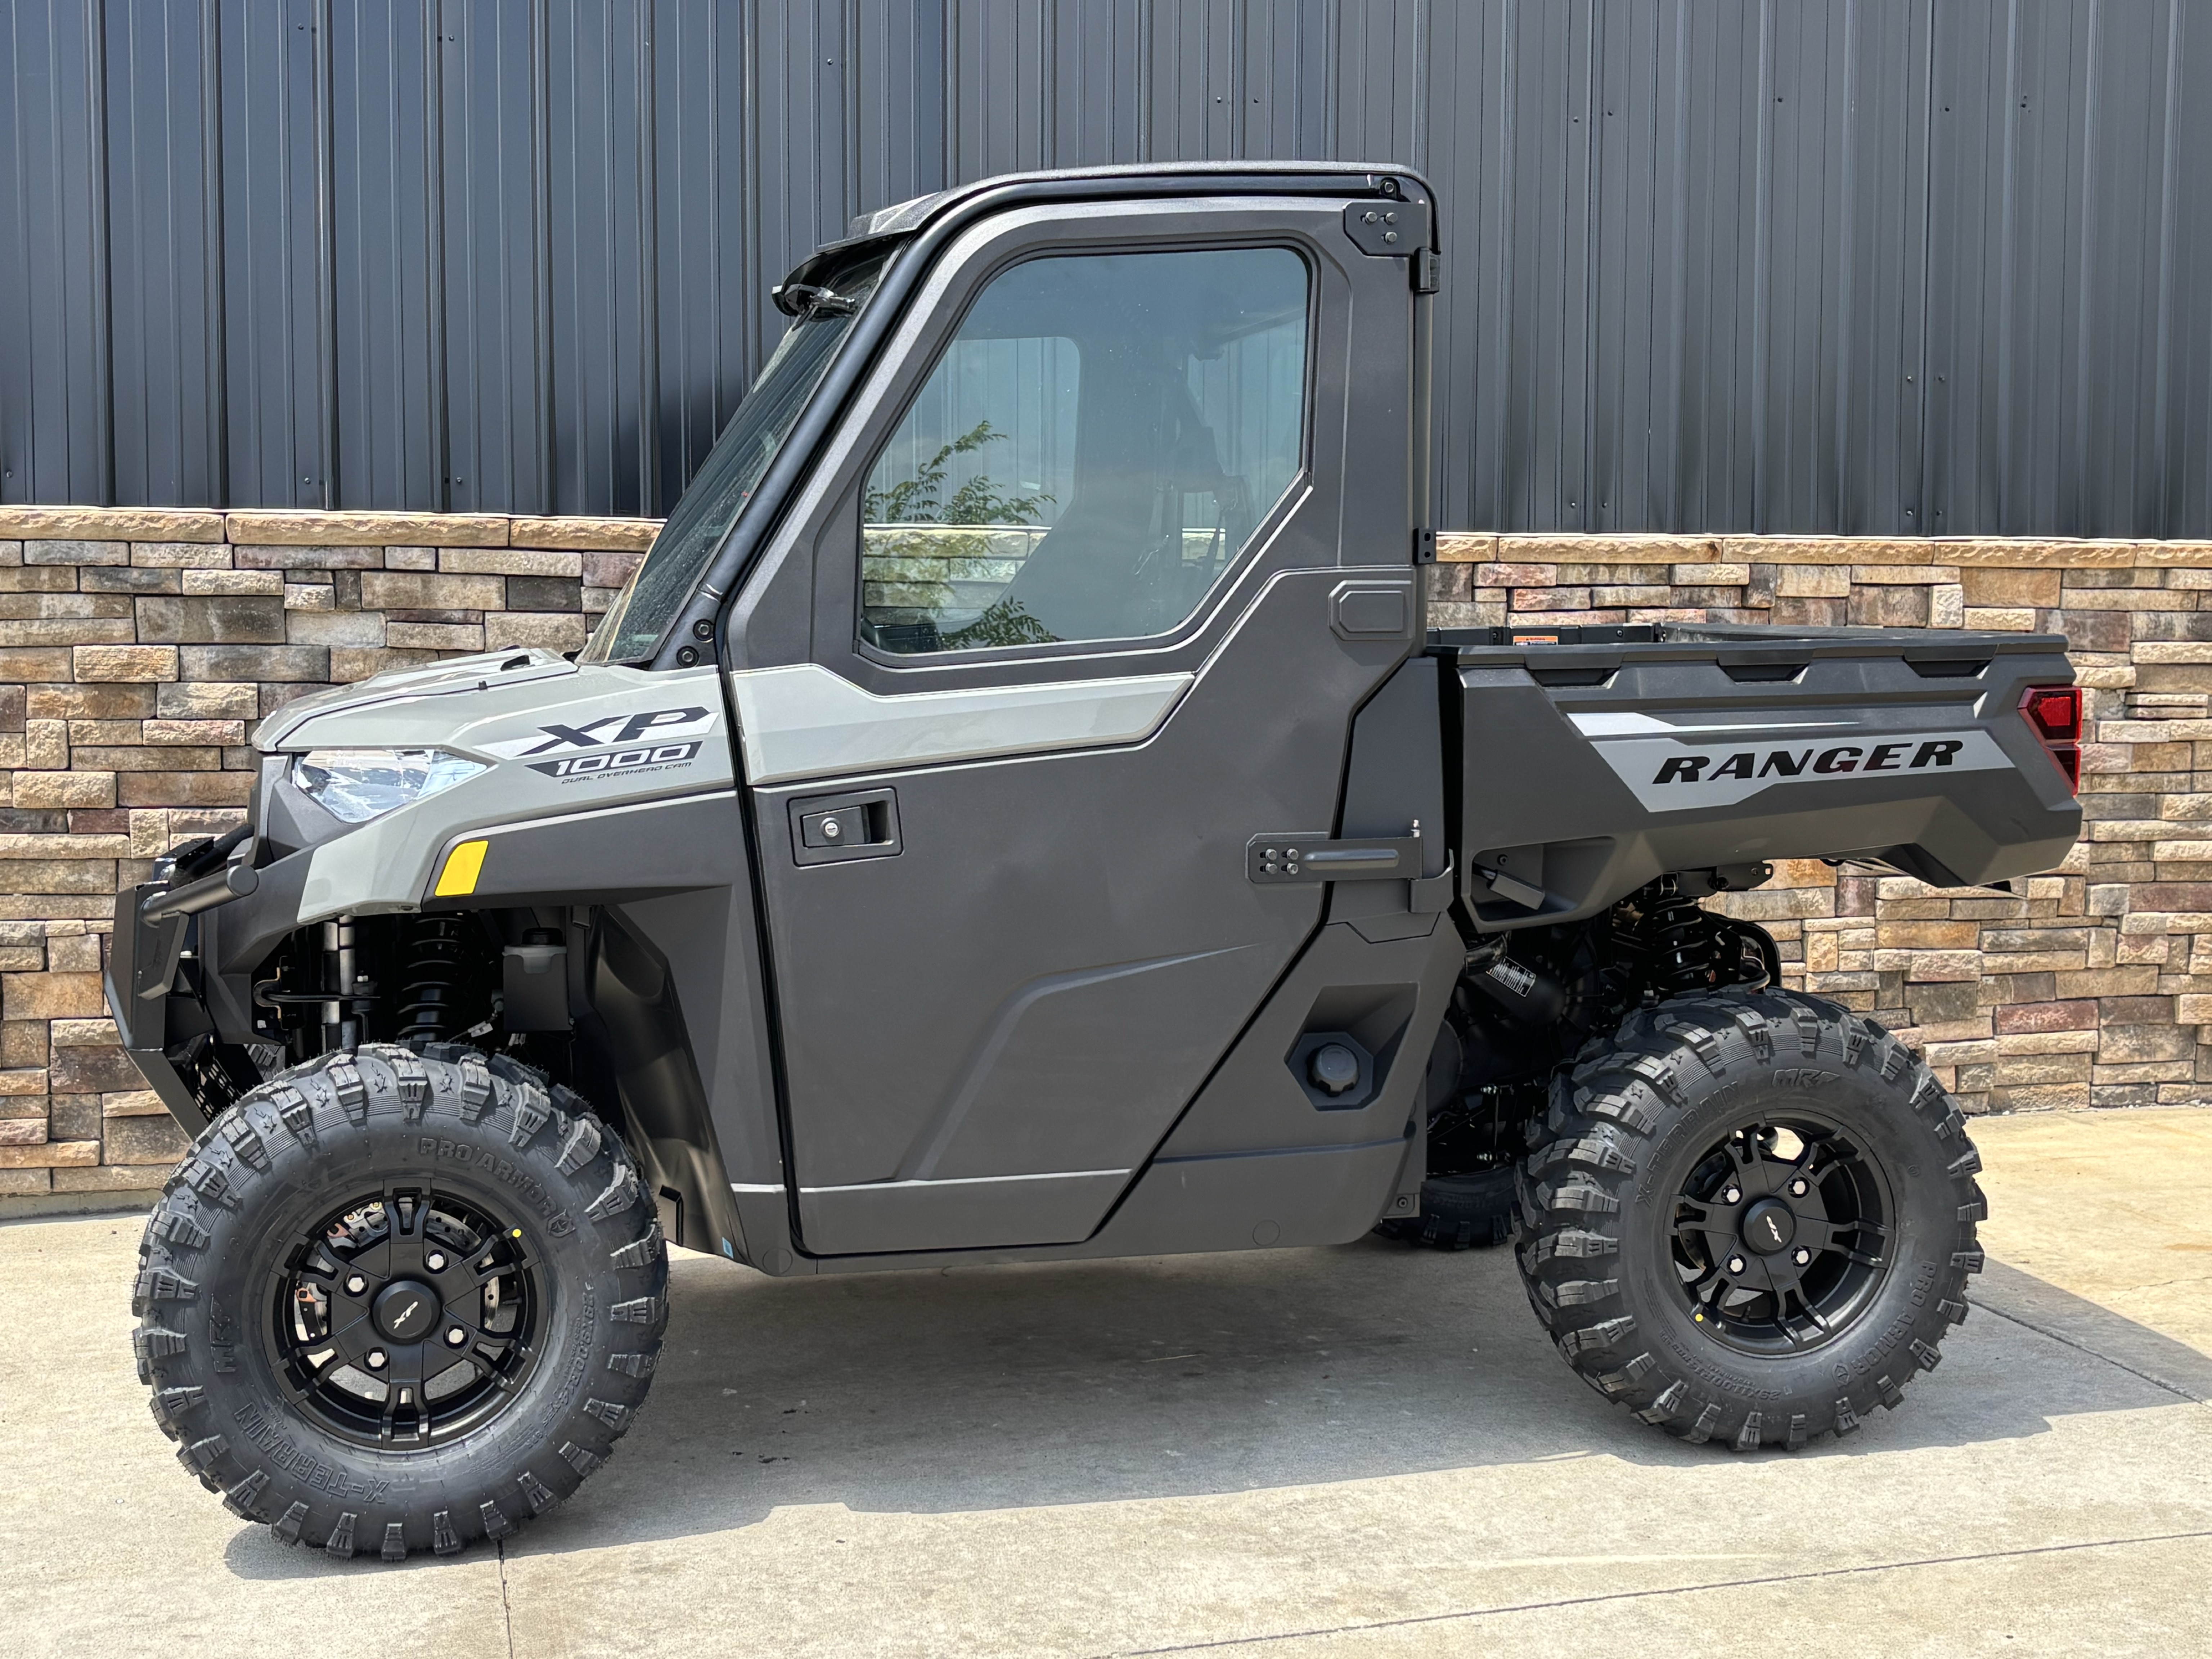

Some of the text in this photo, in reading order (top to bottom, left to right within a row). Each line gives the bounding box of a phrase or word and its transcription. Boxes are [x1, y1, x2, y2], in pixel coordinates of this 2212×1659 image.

[515, 706, 711, 757] XP
[556, 744, 691, 776] 1000
[562, 762, 693, 784] DUAL OVERHEAD CAM
[1652, 740, 1963, 784] RANGER
[1635, 1080, 1743, 1208] X-TERRAIN
[420, 1137, 558, 1217] PRO ARMOR
[1766, 1215, 1782, 1243] XP
[393, 1301, 418, 1329] XP
[1851, 1260, 1937, 1375] PRO ARMOR
[233, 1402, 390, 1504] X-TERRAIN
